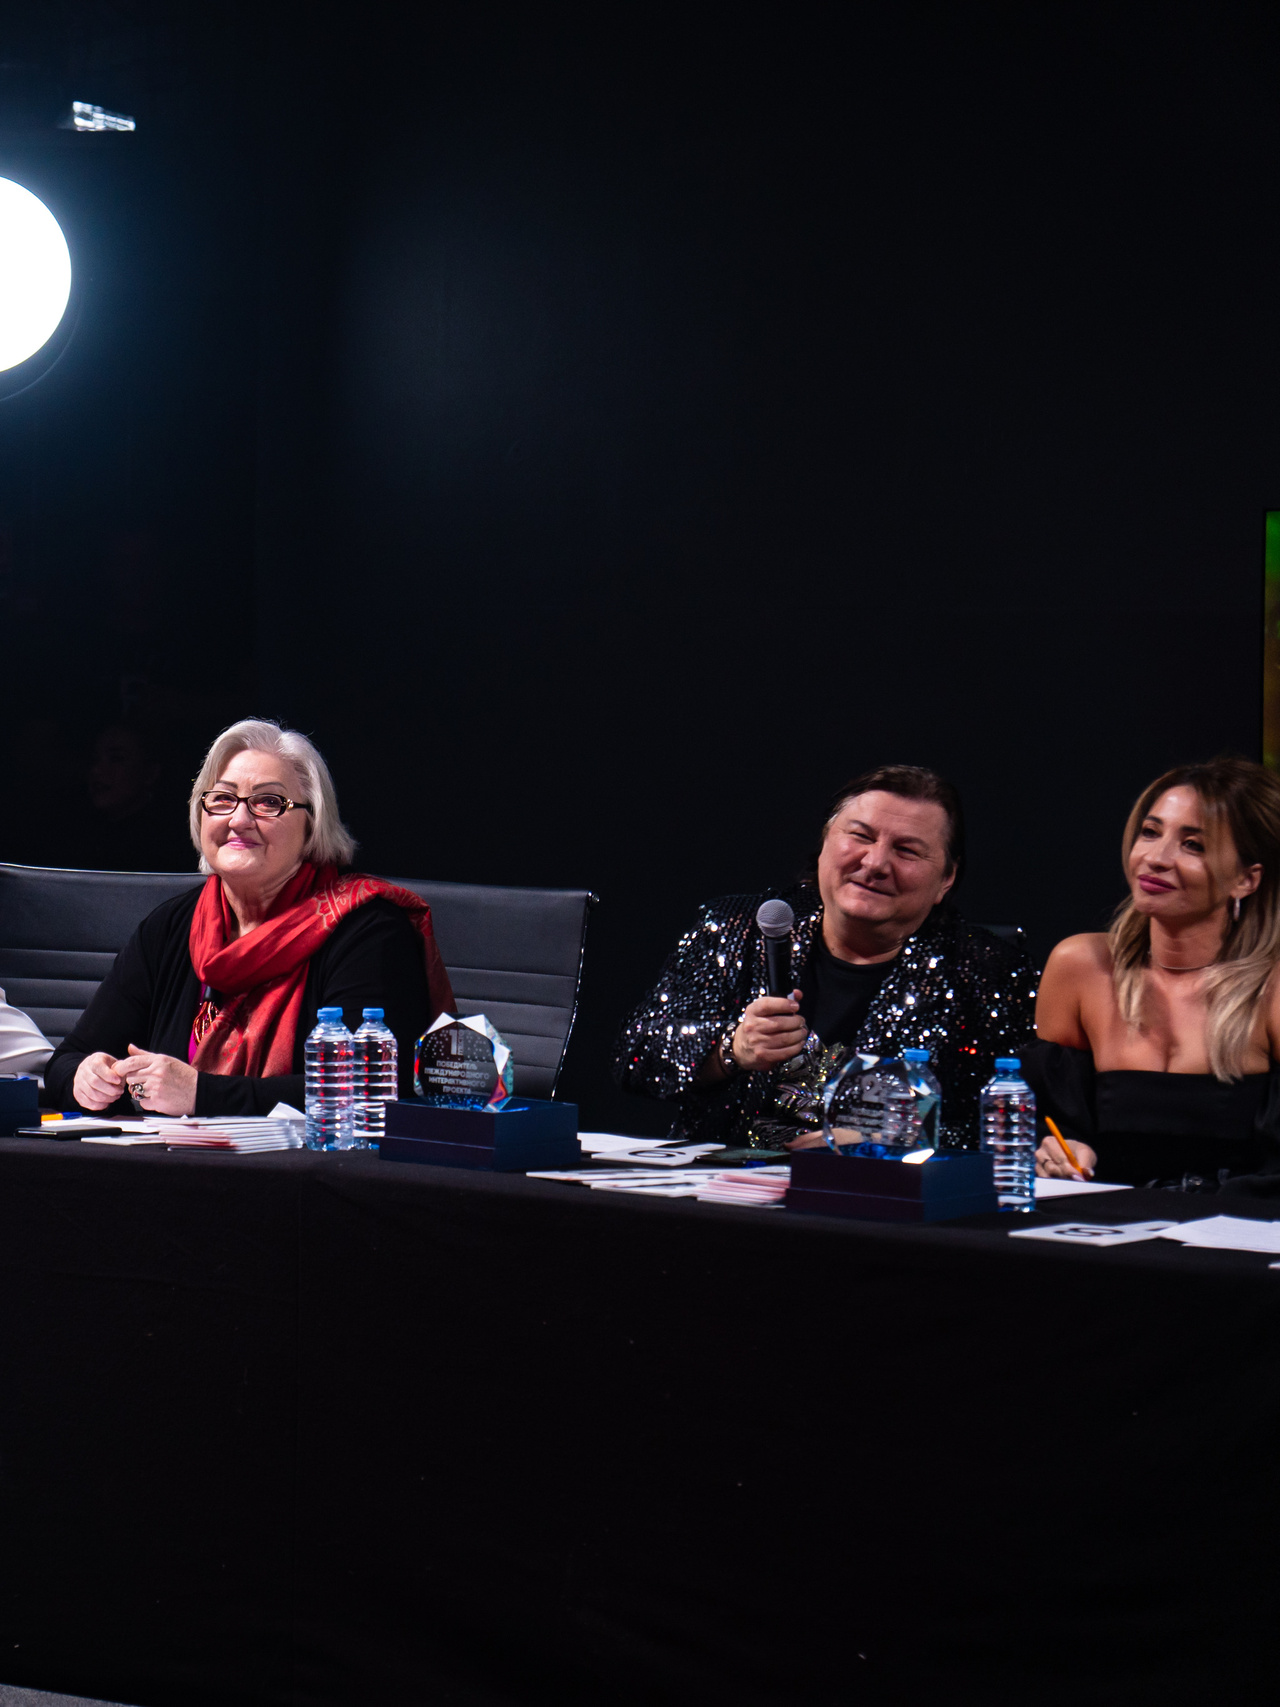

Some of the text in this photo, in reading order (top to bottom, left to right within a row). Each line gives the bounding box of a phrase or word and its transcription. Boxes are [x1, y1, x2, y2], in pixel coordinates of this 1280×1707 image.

[449, 1029, 457, 1055] 1
[436, 1060, 477, 1070] ПОБЕДИТЕЛЬ
[424, 1067, 489, 1079] МЕЖДУНАРОДНОГО
[442, 1085, 472, 1094] ПРОЕКТА
